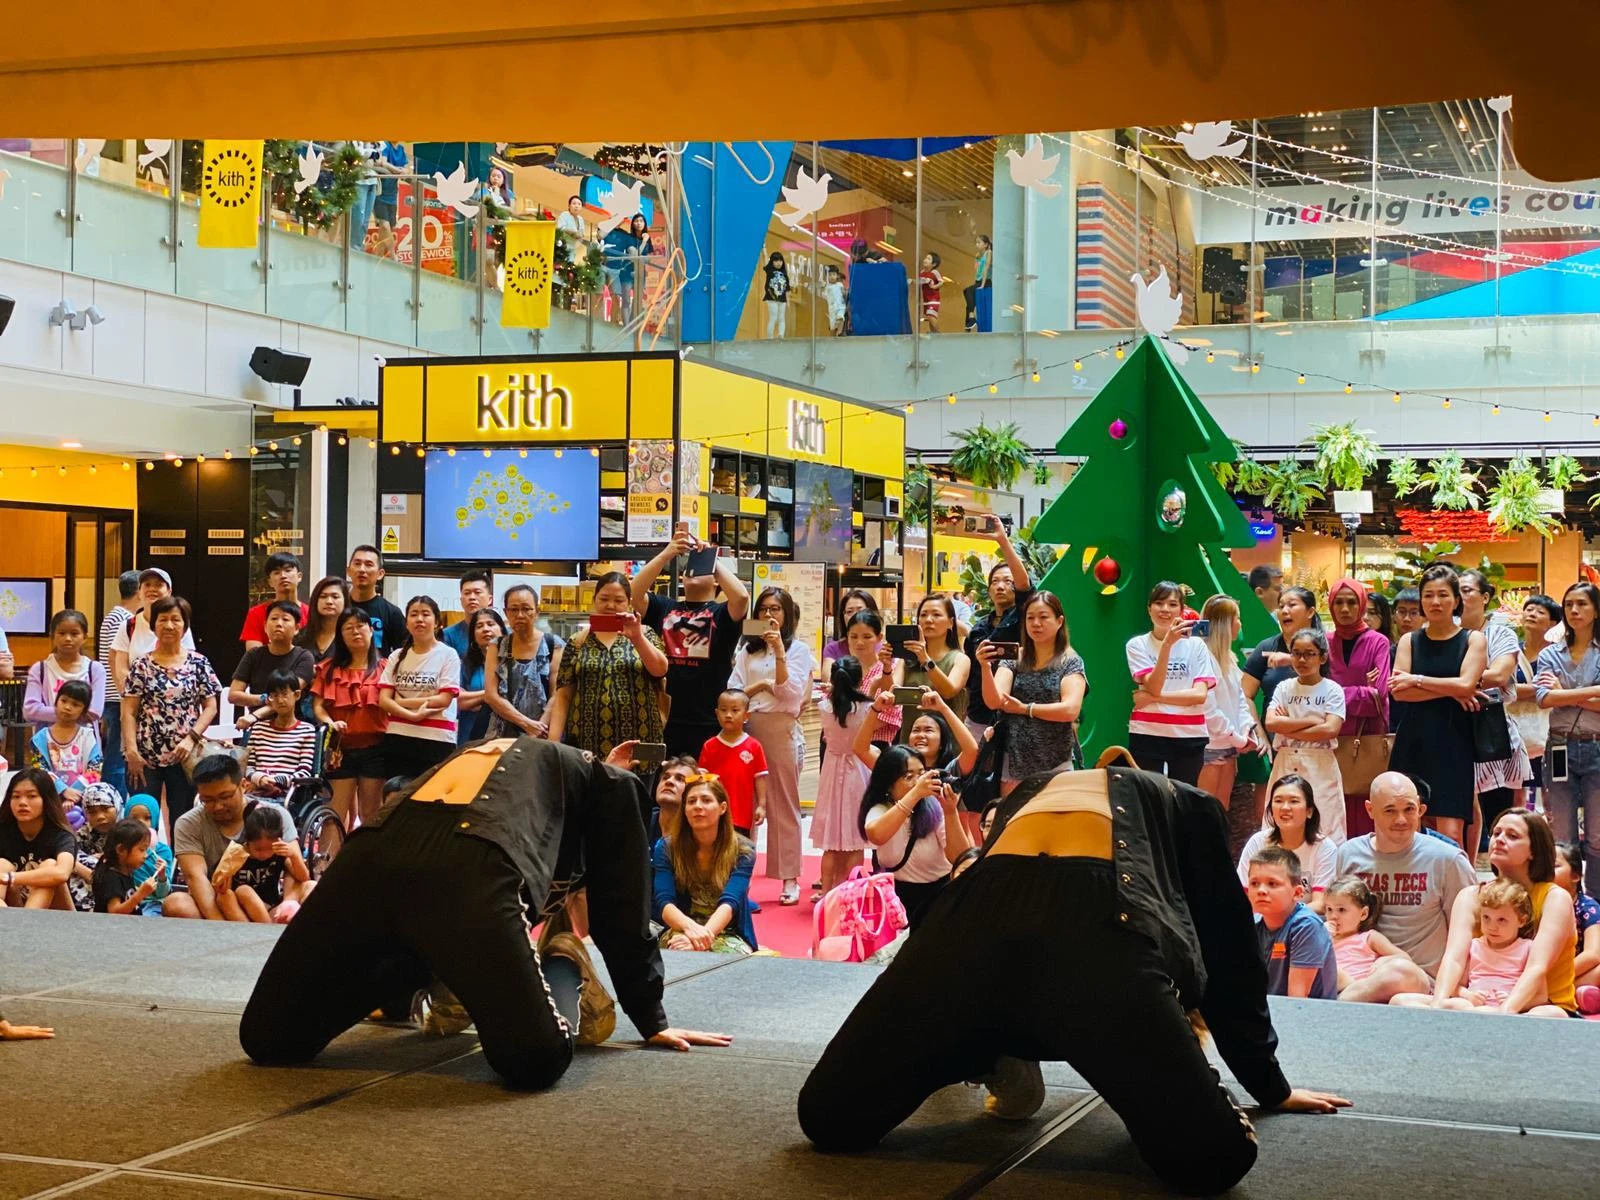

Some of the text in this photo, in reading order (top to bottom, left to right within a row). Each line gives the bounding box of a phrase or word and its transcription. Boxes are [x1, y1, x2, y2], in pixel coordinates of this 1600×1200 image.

[218, 170, 246, 188] kith
[1265, 190, 1600, 226] making lives cou
[518, 267, 539, 280] kith
[476, 373, 573, 431] kith
[788, 398, 825, 456] kith
[1394, 872, 1428, 892] TECH
